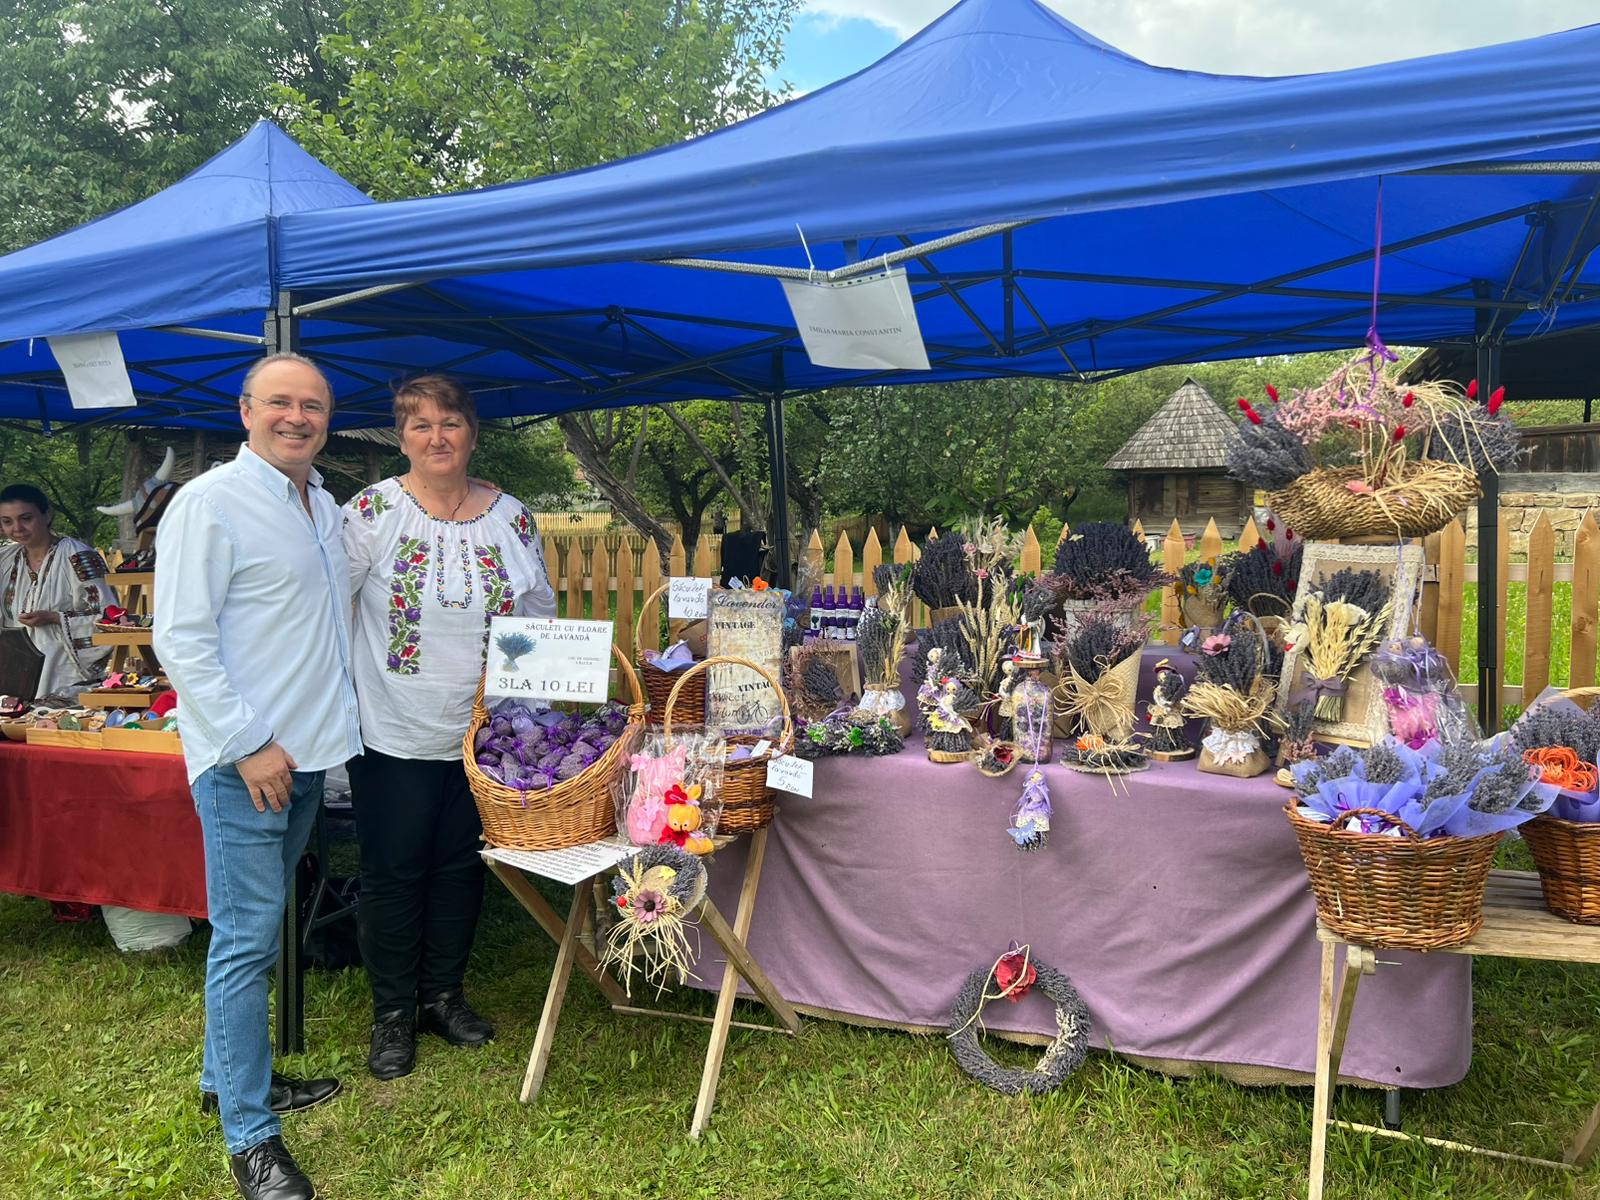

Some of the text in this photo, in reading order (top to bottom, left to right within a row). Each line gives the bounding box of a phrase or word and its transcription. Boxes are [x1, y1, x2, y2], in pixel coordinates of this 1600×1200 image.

[831, 328, 854, 336] MARIA
[855, 327, 902, 336] CONSTANTIN
[577, 625, 608, 633] FLOARE
[714, 621, 756, 630] VINTAGE
[566, 680, 595, 693] LEI
